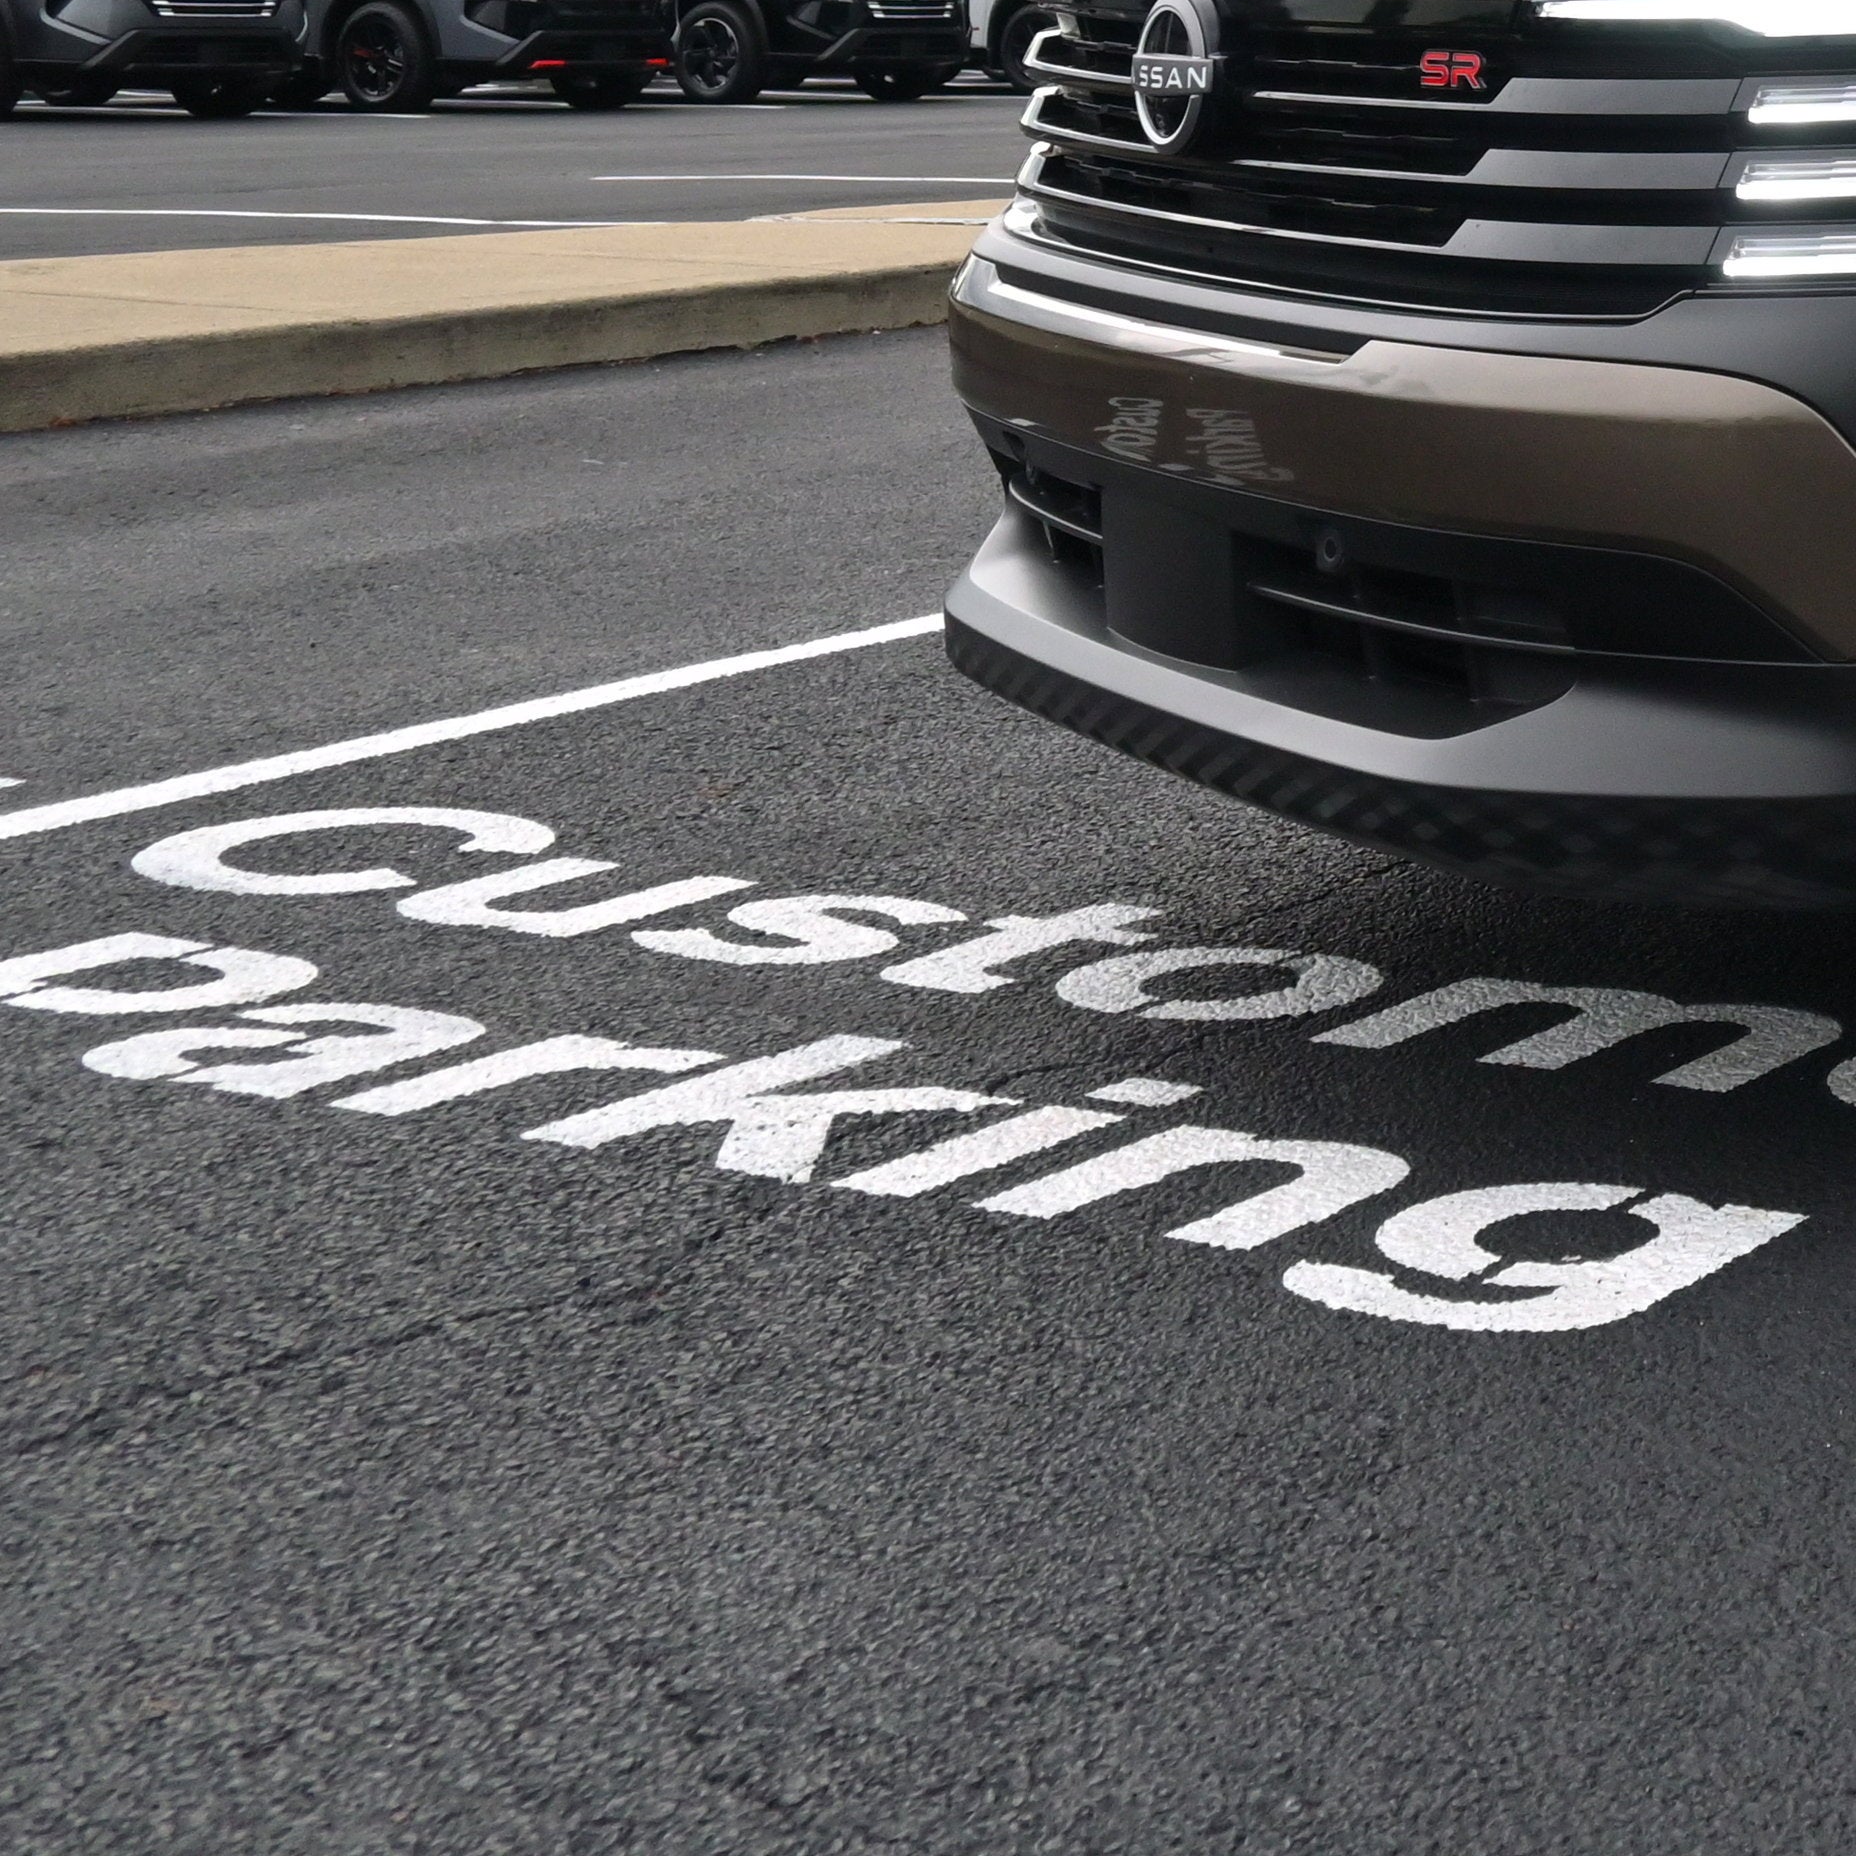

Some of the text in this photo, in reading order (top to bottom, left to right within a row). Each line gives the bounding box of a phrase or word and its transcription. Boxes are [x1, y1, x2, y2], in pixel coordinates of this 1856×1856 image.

[1137, 63, 1208, 90] SSAN
[1420, 50, 1486, 90] SR
[0, 931, 1809, 1332] Parking
